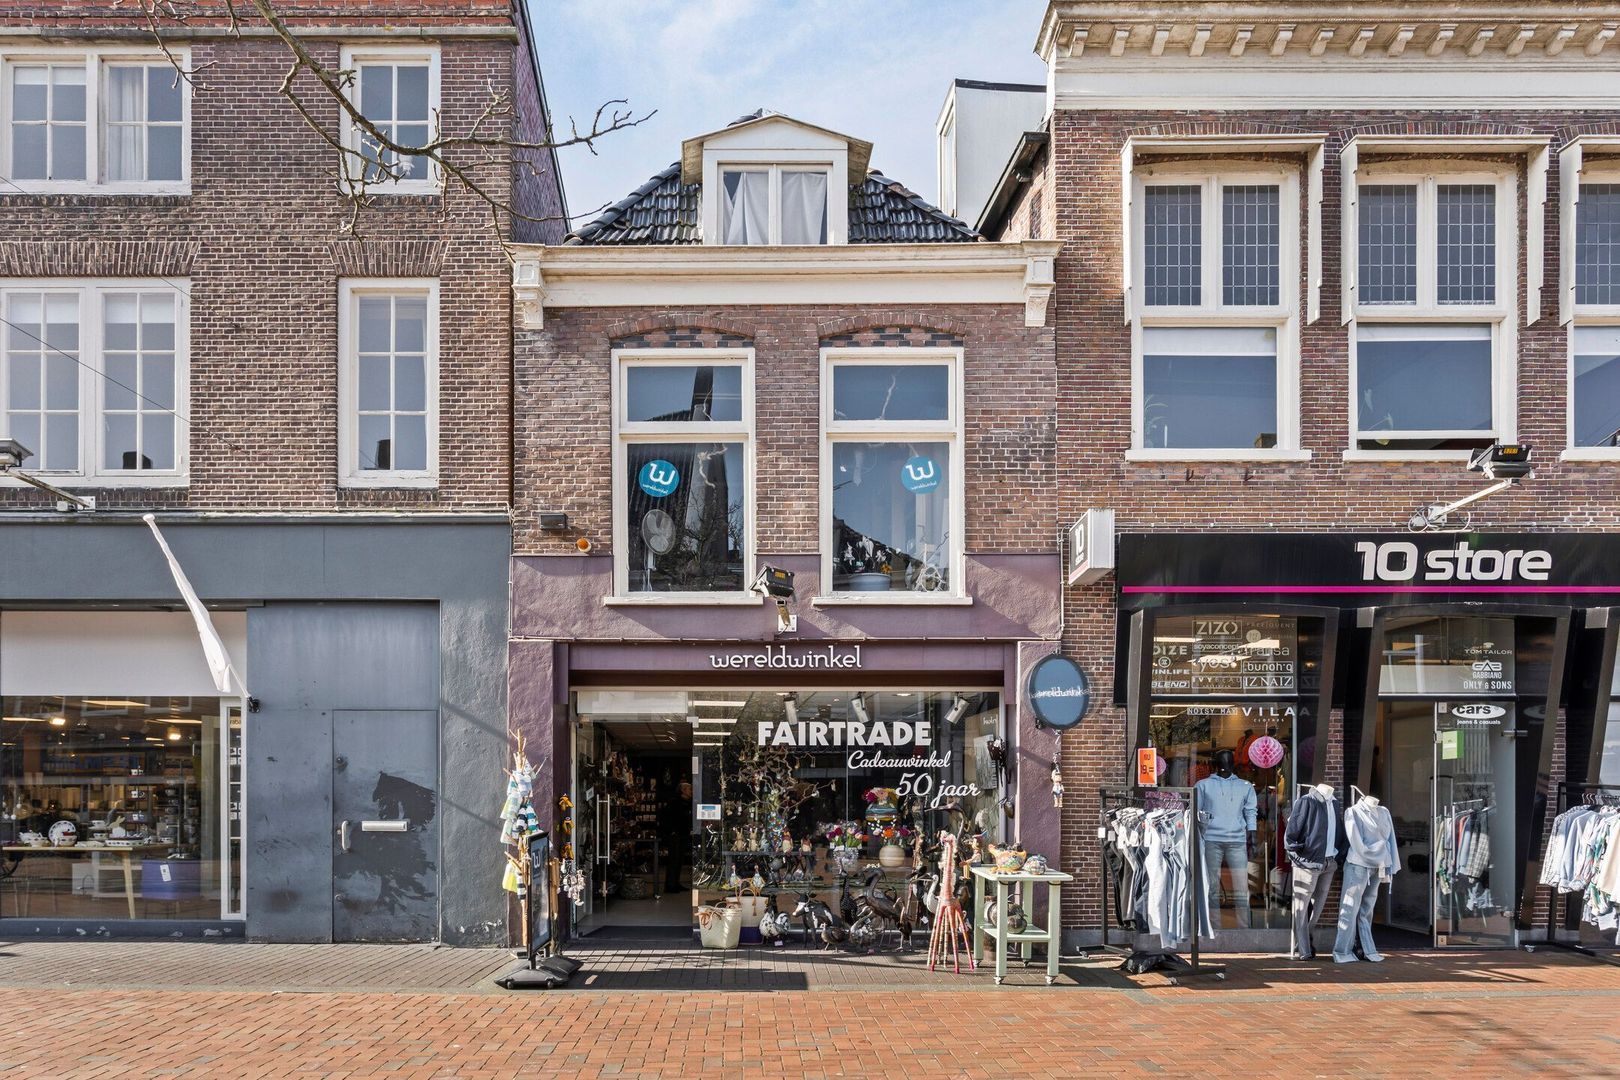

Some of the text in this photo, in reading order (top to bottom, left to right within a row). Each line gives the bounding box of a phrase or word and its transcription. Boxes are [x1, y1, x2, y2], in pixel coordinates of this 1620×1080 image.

[1356, 541, 1552, 581] 10 store
[709, 644, 863, 669] wereldwinkel
[1463, 680, 1482, 689] ONLY
[1490, 680, 1512, 689] SONS
[1242, 706, 1296, 717] VILA
[1456, 705, 1492, 715] cars
[757, 720, 932, 746] FAIRTRADE
[846, 750, 951, 770] Cadeauwinkel
[895, 772, 981, 809] 50 jaar
